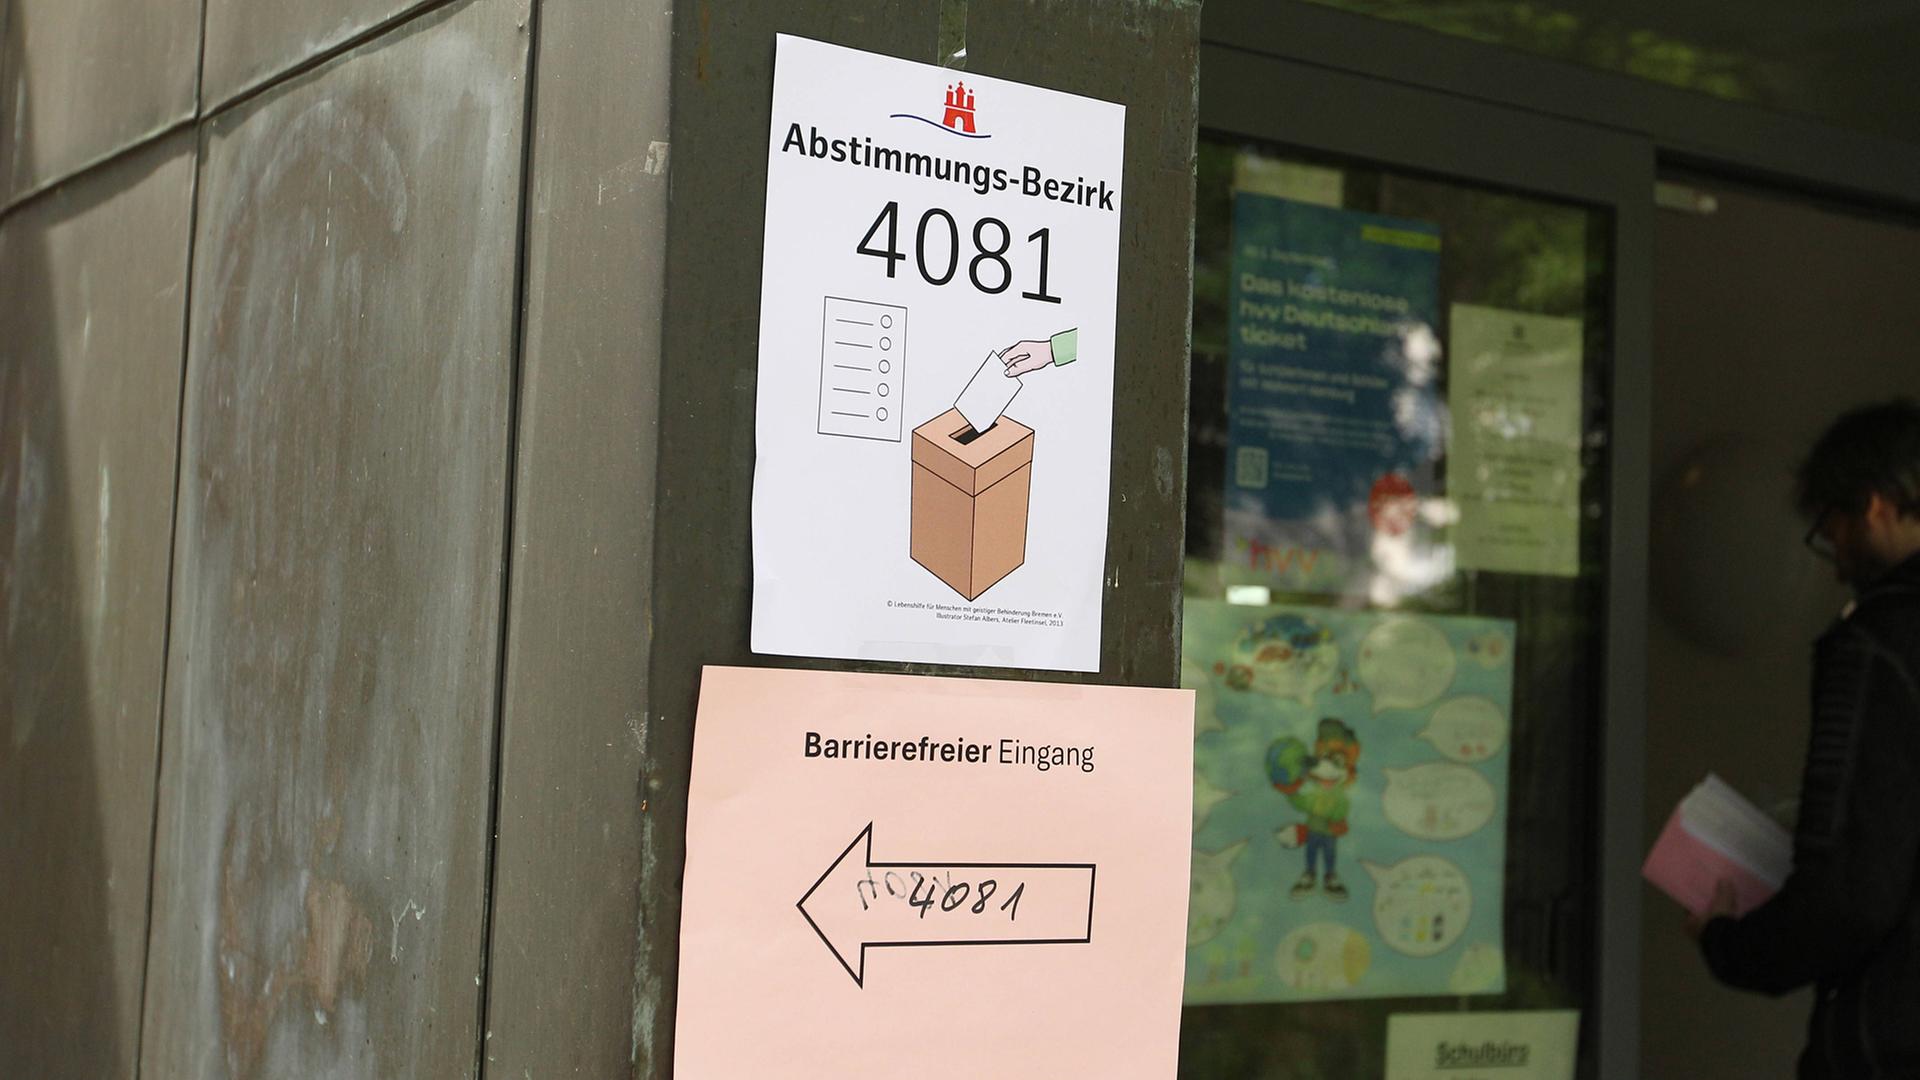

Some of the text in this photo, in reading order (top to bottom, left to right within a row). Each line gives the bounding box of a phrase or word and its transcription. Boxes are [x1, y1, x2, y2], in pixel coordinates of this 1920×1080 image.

[782, 122, 1114, 211] Abstimmungs-Bezirk
[856, 201, 1061, 304] 4081
[894, 601, 925, 609] Lebenshilfe
[972, 607, 996, 615] geistiger
[997, 608, 1031, 617] Behinderung
[1032, 610, 1052, 618] Bremen
[804, 731, 1095, 773] Barrierefreier Eingang
[909, 876, 1025, 921] 4081
